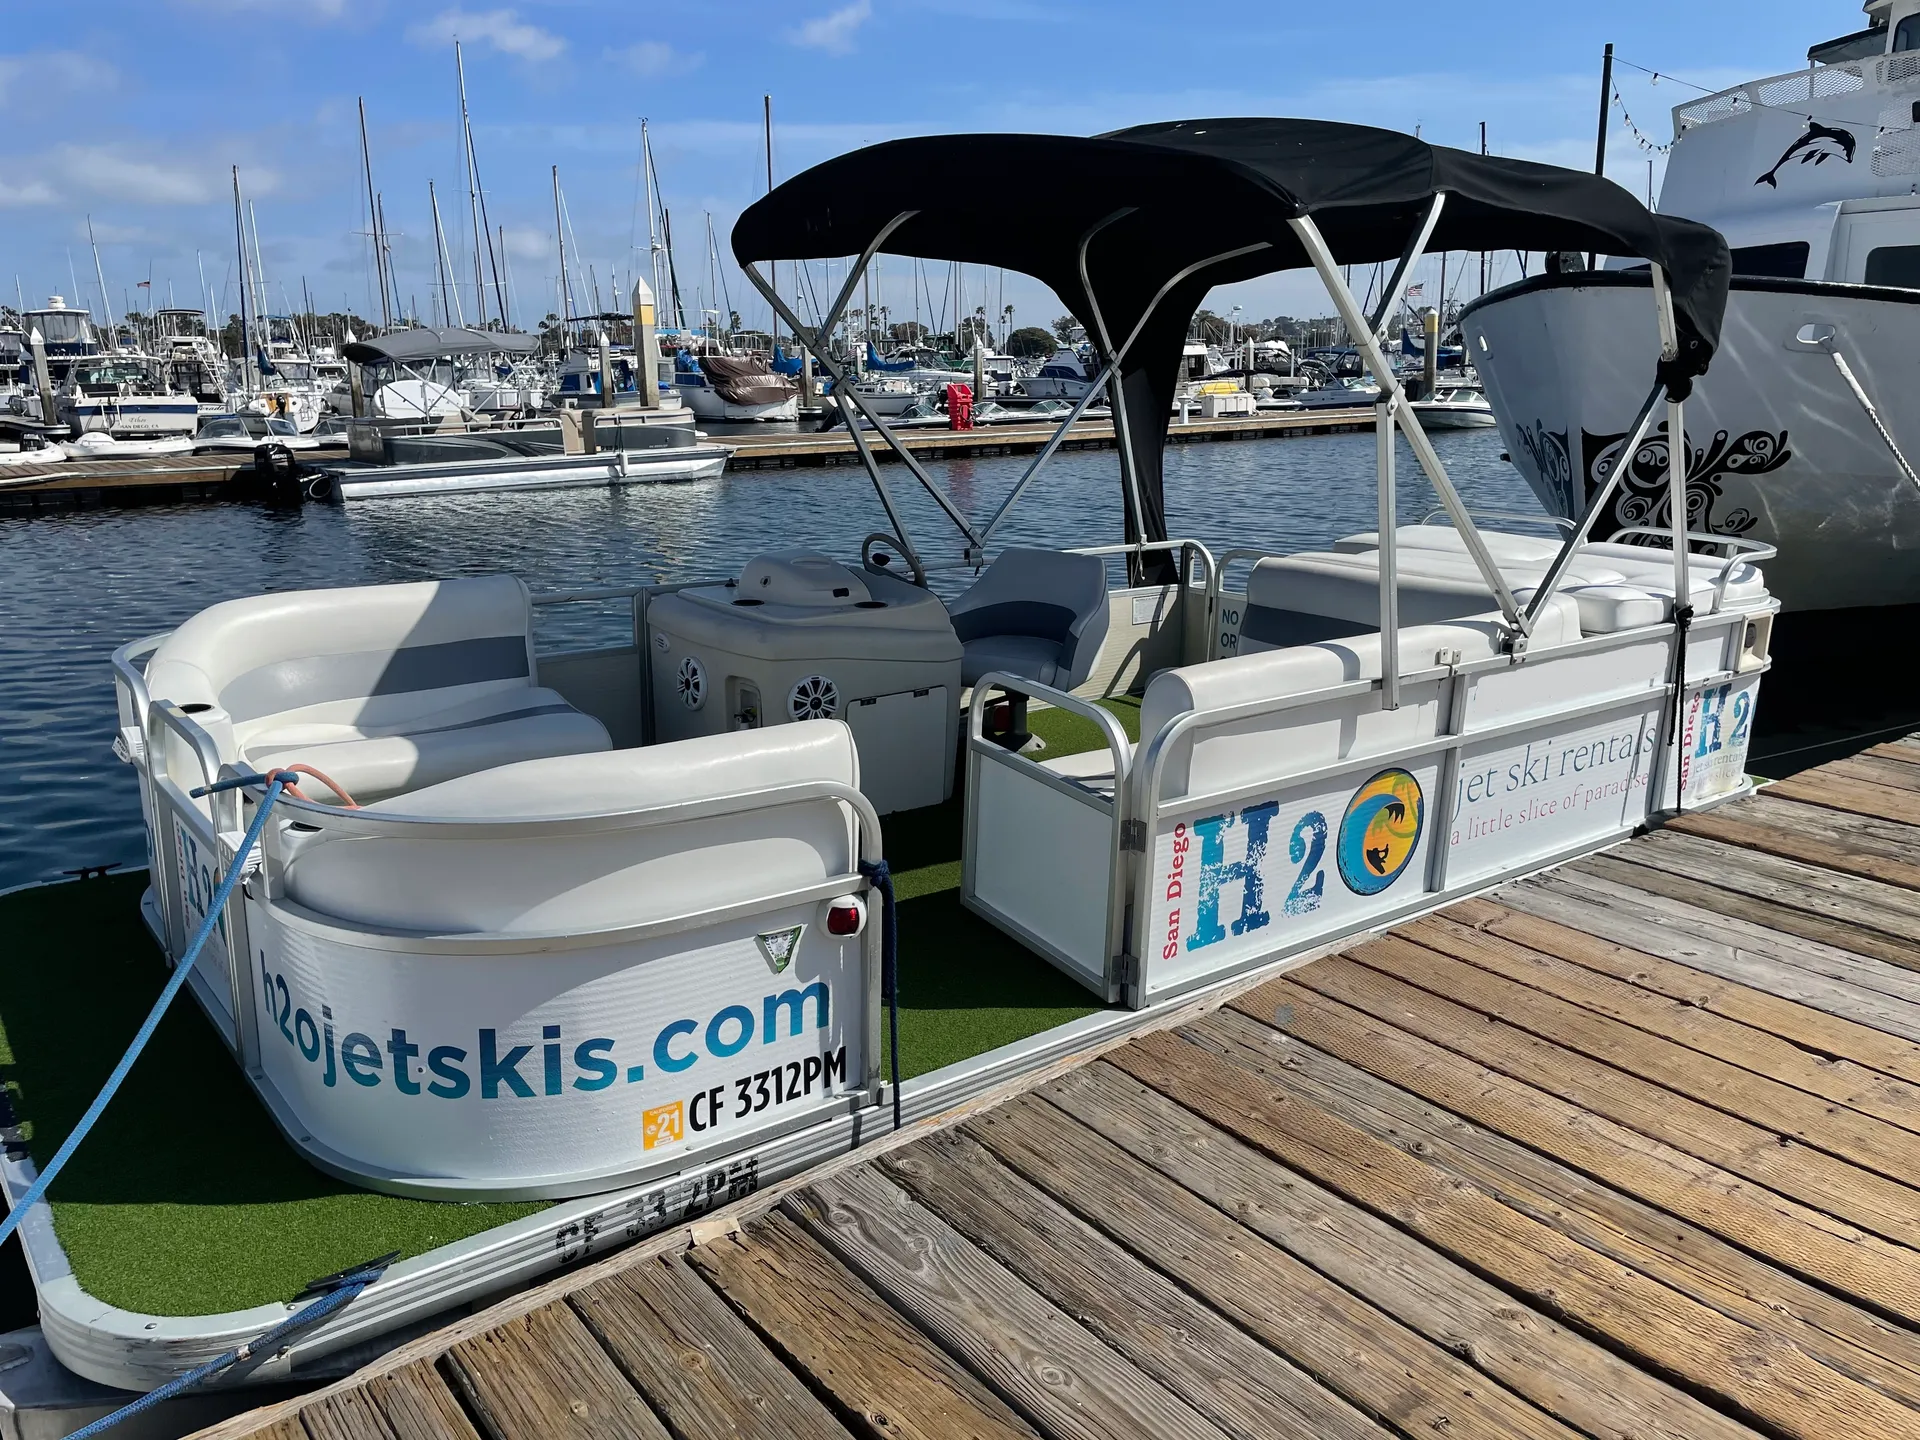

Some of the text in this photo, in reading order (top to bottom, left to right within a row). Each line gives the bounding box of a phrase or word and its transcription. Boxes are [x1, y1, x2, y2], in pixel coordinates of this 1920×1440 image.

[1221, 632, 1237, 649] OR
[1222, 608, 1239, 626] NO
[1451, 727, 1656, 823] jet ski rentals
[1680, 691, 1701, 791] San Diego
[1450, 768, 1649, 846] a little slice of paradise
[1163, 822, 1190, 961] San Diego
[260, 948, 830, 1100] h2ojetskis.com
[657, 1109, 680, 1138] 21
[689, 1046, 847, 1132] CF 3312PM
